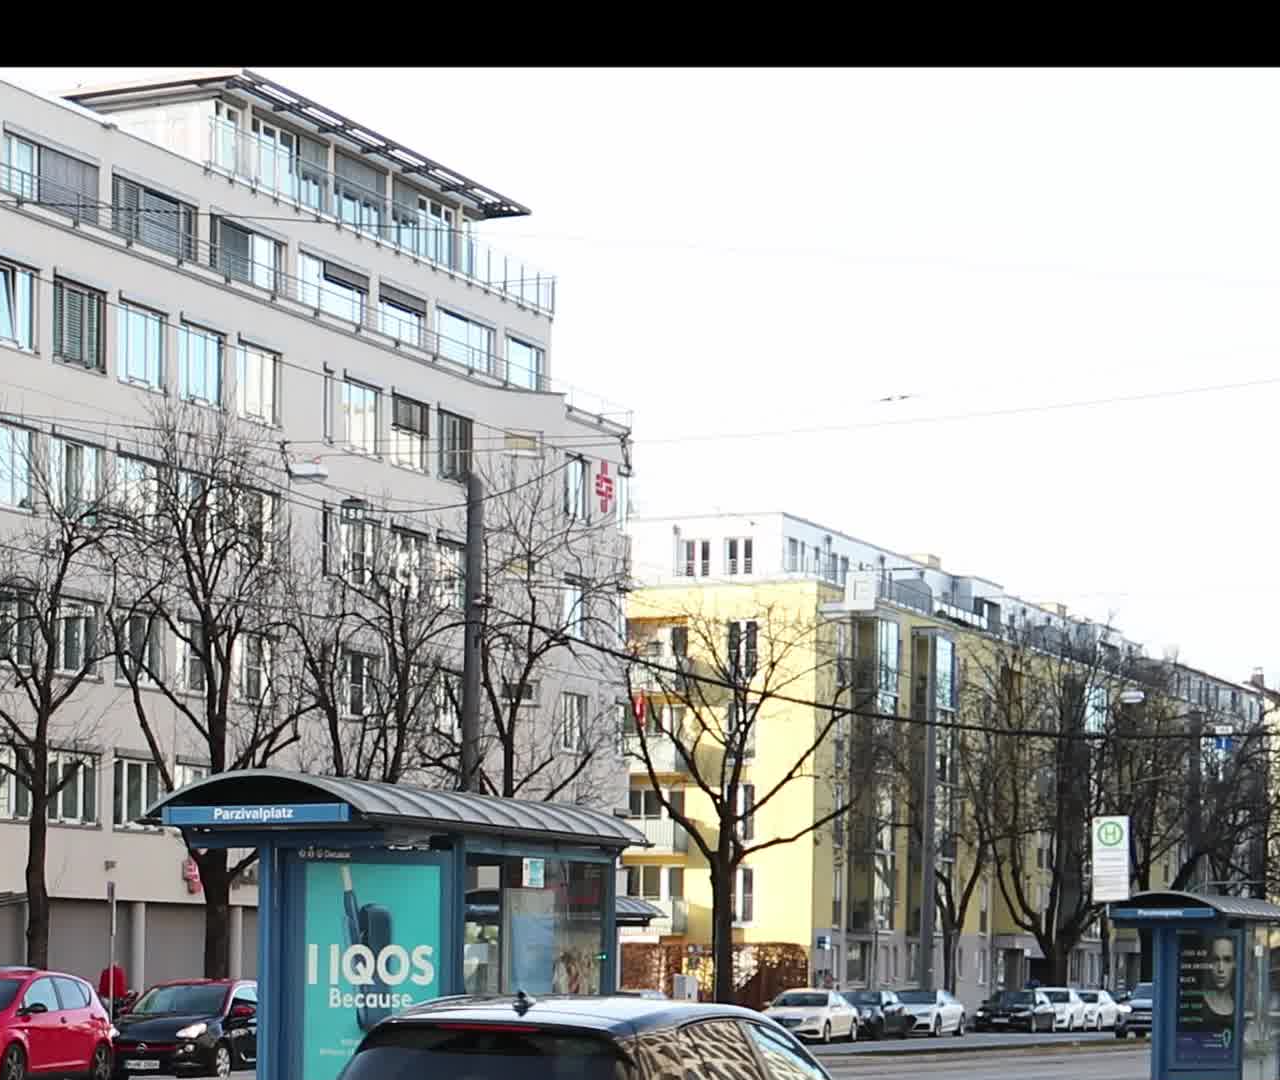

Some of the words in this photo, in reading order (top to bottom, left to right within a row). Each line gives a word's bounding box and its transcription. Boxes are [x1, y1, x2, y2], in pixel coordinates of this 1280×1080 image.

[213, 807, 294, 822] Parzivalplatz
[307, 943, 318, 985] I
[329, 943, 435, 986] IQOS
[329, 987, 413, 1009] Because
